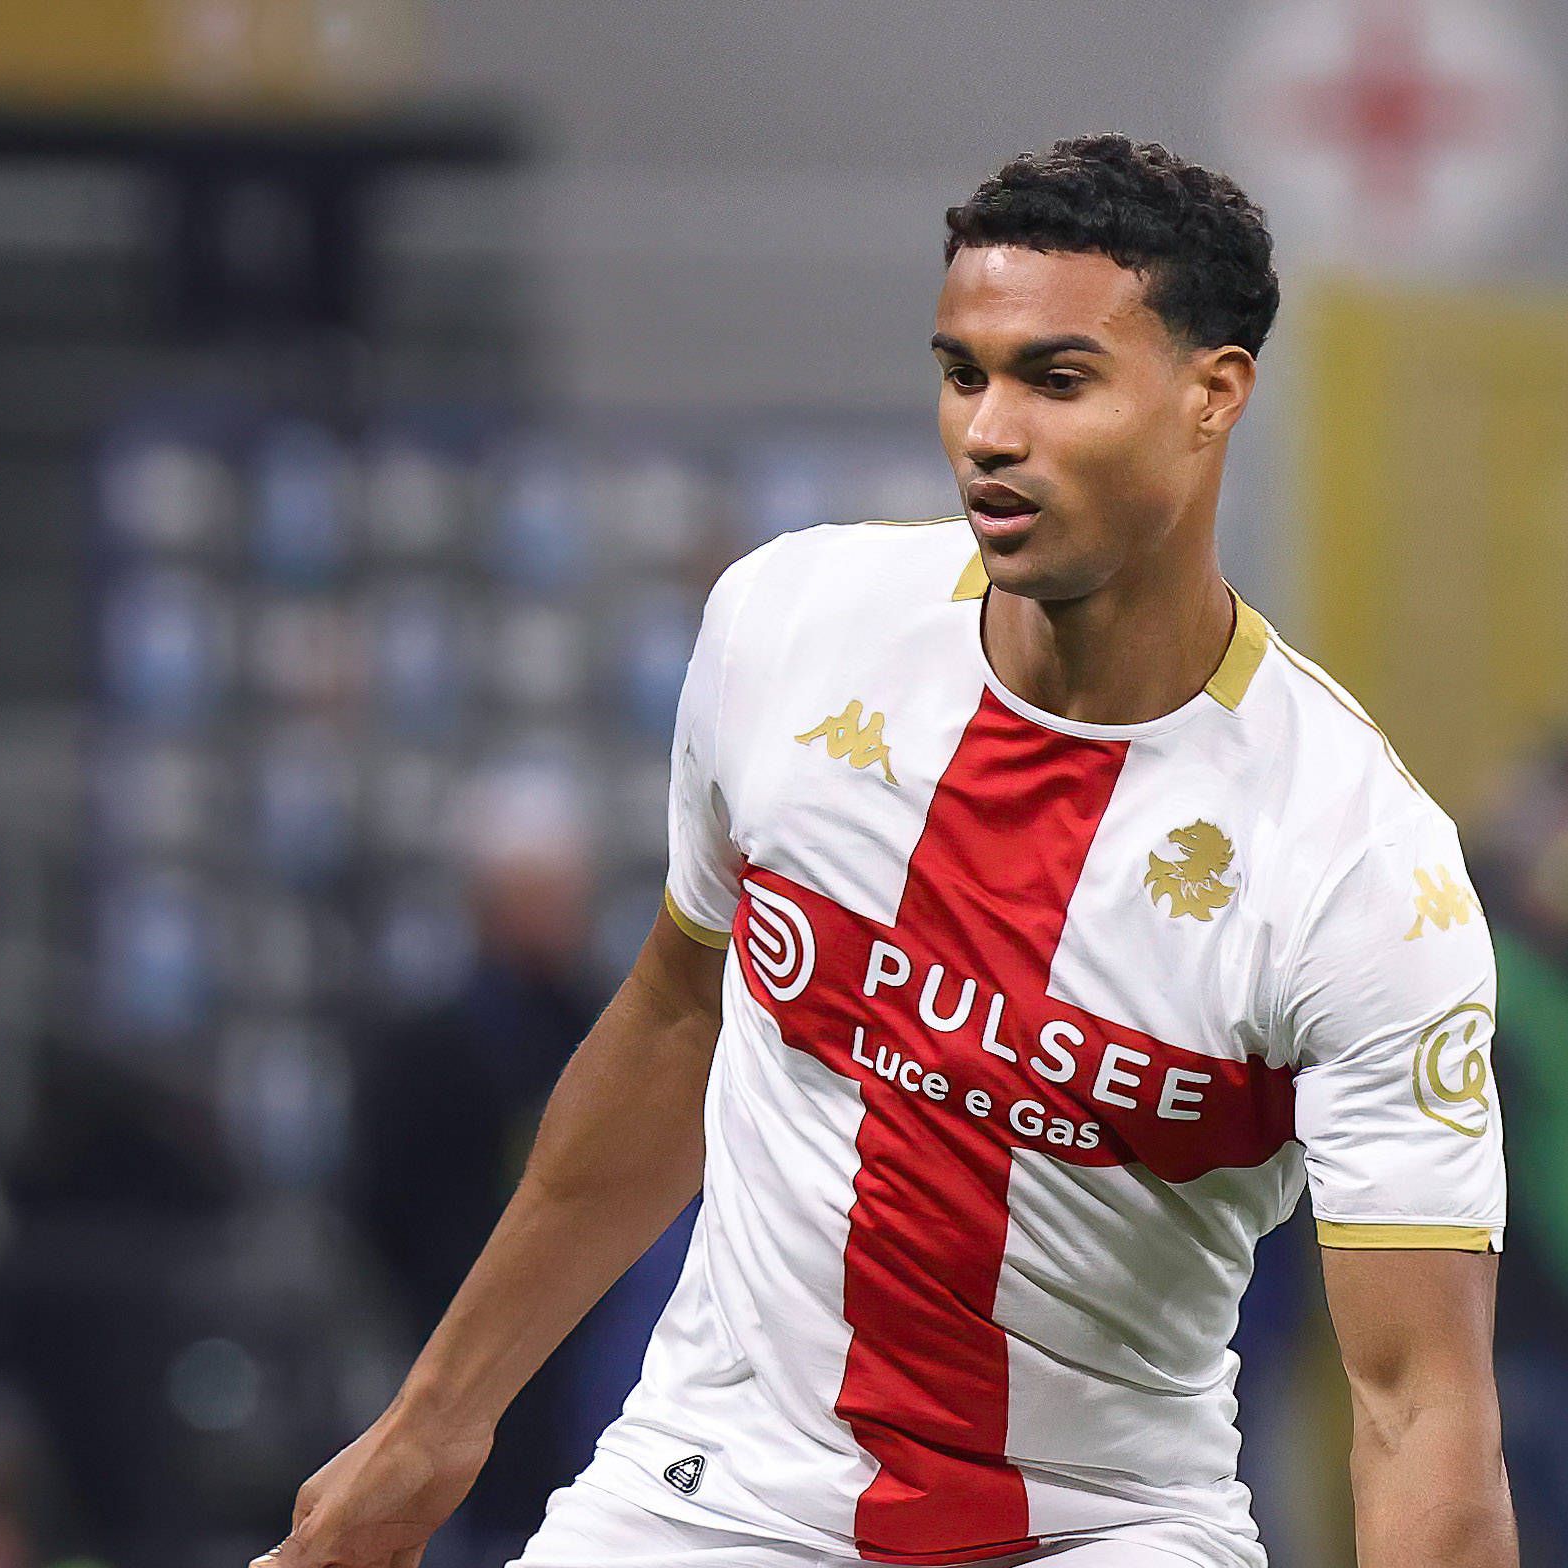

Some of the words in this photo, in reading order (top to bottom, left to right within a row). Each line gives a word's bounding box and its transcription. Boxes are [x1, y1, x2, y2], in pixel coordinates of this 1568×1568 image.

[851, 1025, 950, 1102] Luce
[964, 1088, 993, 1118] e
[1008, 1099, 1101, 1150] Gas
[863, 939, 1213, 1121] PULSEE
